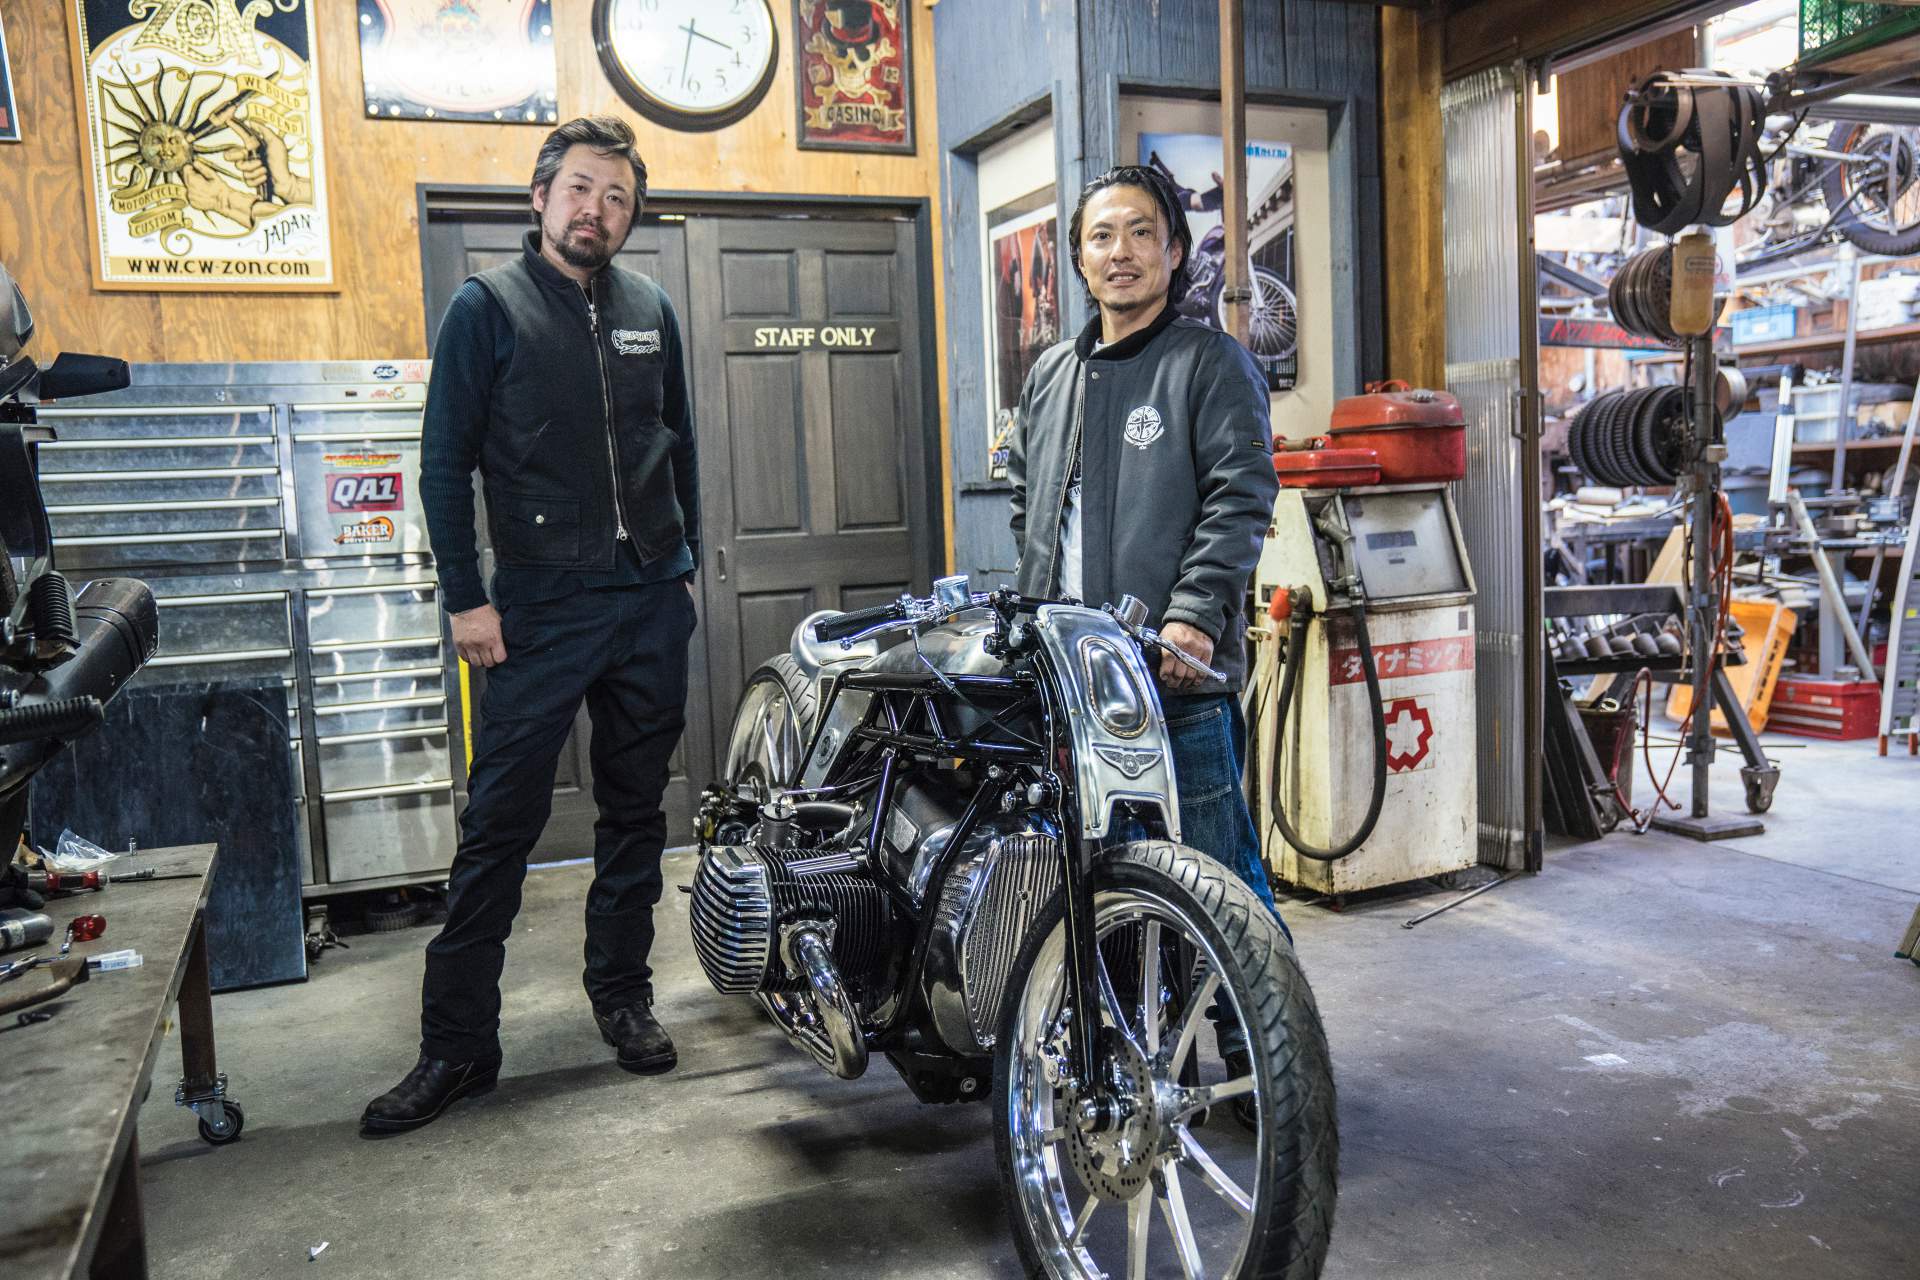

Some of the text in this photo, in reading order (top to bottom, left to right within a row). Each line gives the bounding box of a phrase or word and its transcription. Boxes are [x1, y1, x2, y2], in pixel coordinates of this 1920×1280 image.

[740, 25, 752, 44] 3
[730, 50, 743, 68] 4
[664, 66, 676, 85] 7
[687, 72, 701, 94] 6
[715, 68, 728, 88] 5
[117, 186, 181, 210] MOTORCYCLE
[134, 212, 177, 235] CUSTOM
[263, 213, 313, 253] JAPAN
[754, 326, 876, 347] STAFF ONLY
[333, 477, 397, 508] QA1
[342, 524, 388, 537] BAKER
